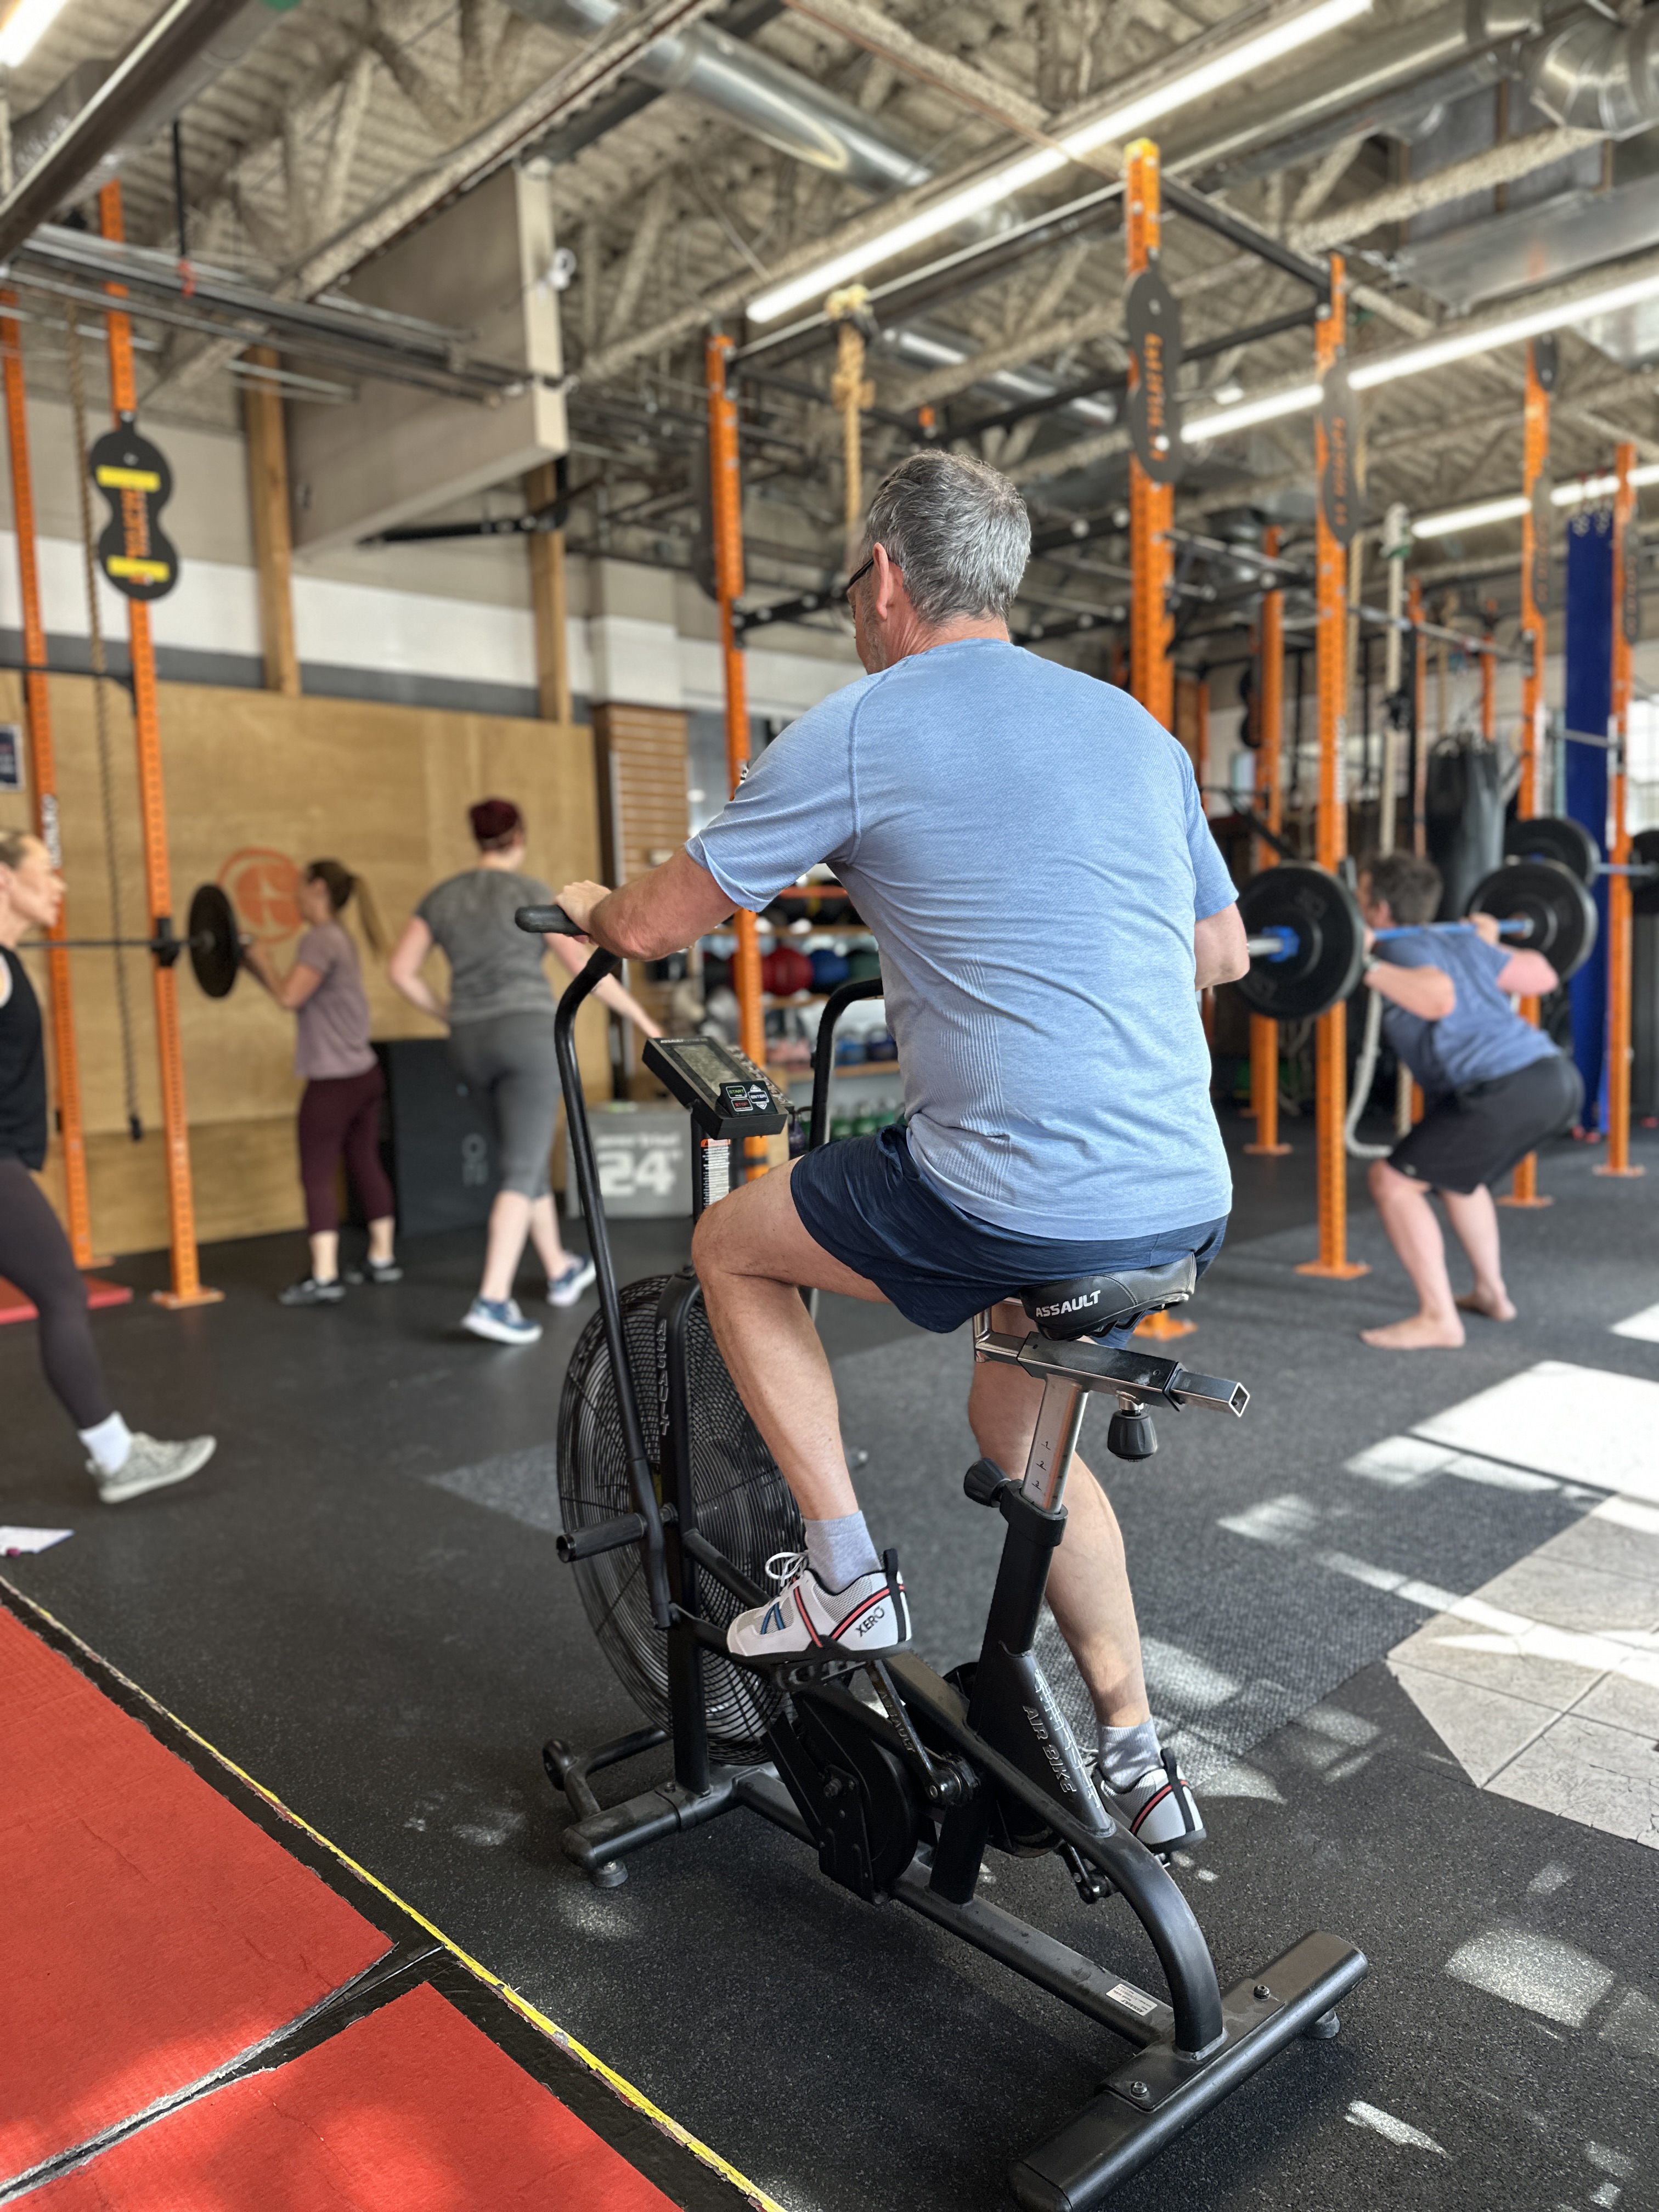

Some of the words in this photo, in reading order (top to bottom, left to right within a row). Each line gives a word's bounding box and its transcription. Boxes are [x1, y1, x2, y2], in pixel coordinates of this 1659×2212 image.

[1036, 1290, 1101, 1317] ASSAULT
[656, 1319, 670, 1436] ASSAULT
[855, 1605, 884, 1637] XERO
[1023, 1706, 1048, 1740] AIR
[1042, 1739, 1077, 1793] BIKE
